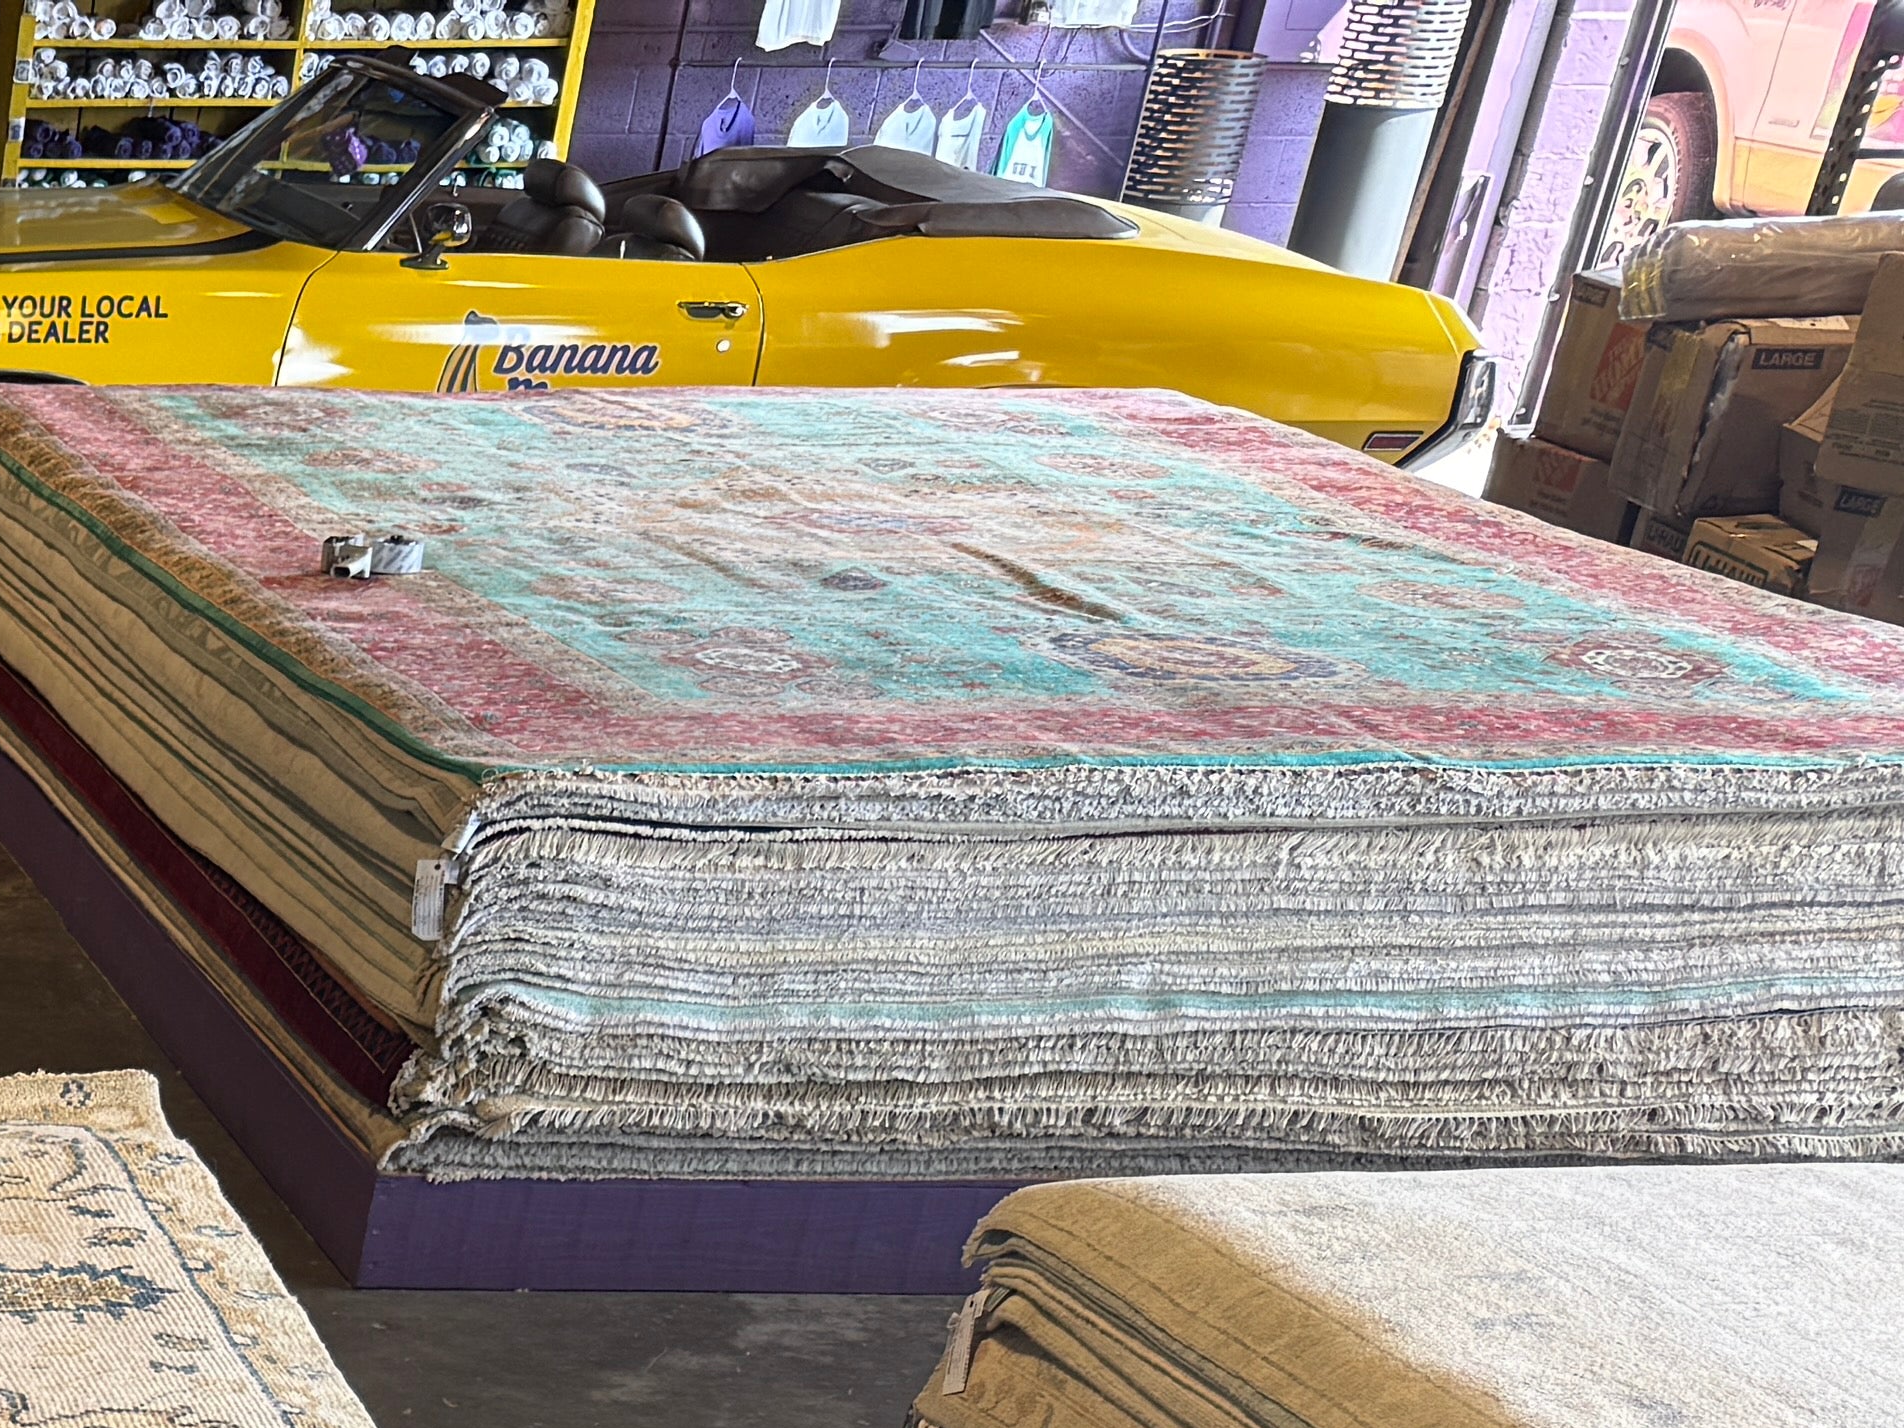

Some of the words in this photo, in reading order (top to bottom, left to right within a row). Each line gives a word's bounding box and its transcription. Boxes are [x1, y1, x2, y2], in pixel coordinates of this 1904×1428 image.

[1, 295, 73, 318] YOUR
[80, 295, 169, 318] LOCAL
[6, 320, 110, 344] DEALER
[493, 326, 660, 375] Banana
[1759, 351, 1816, 366] LARGE
